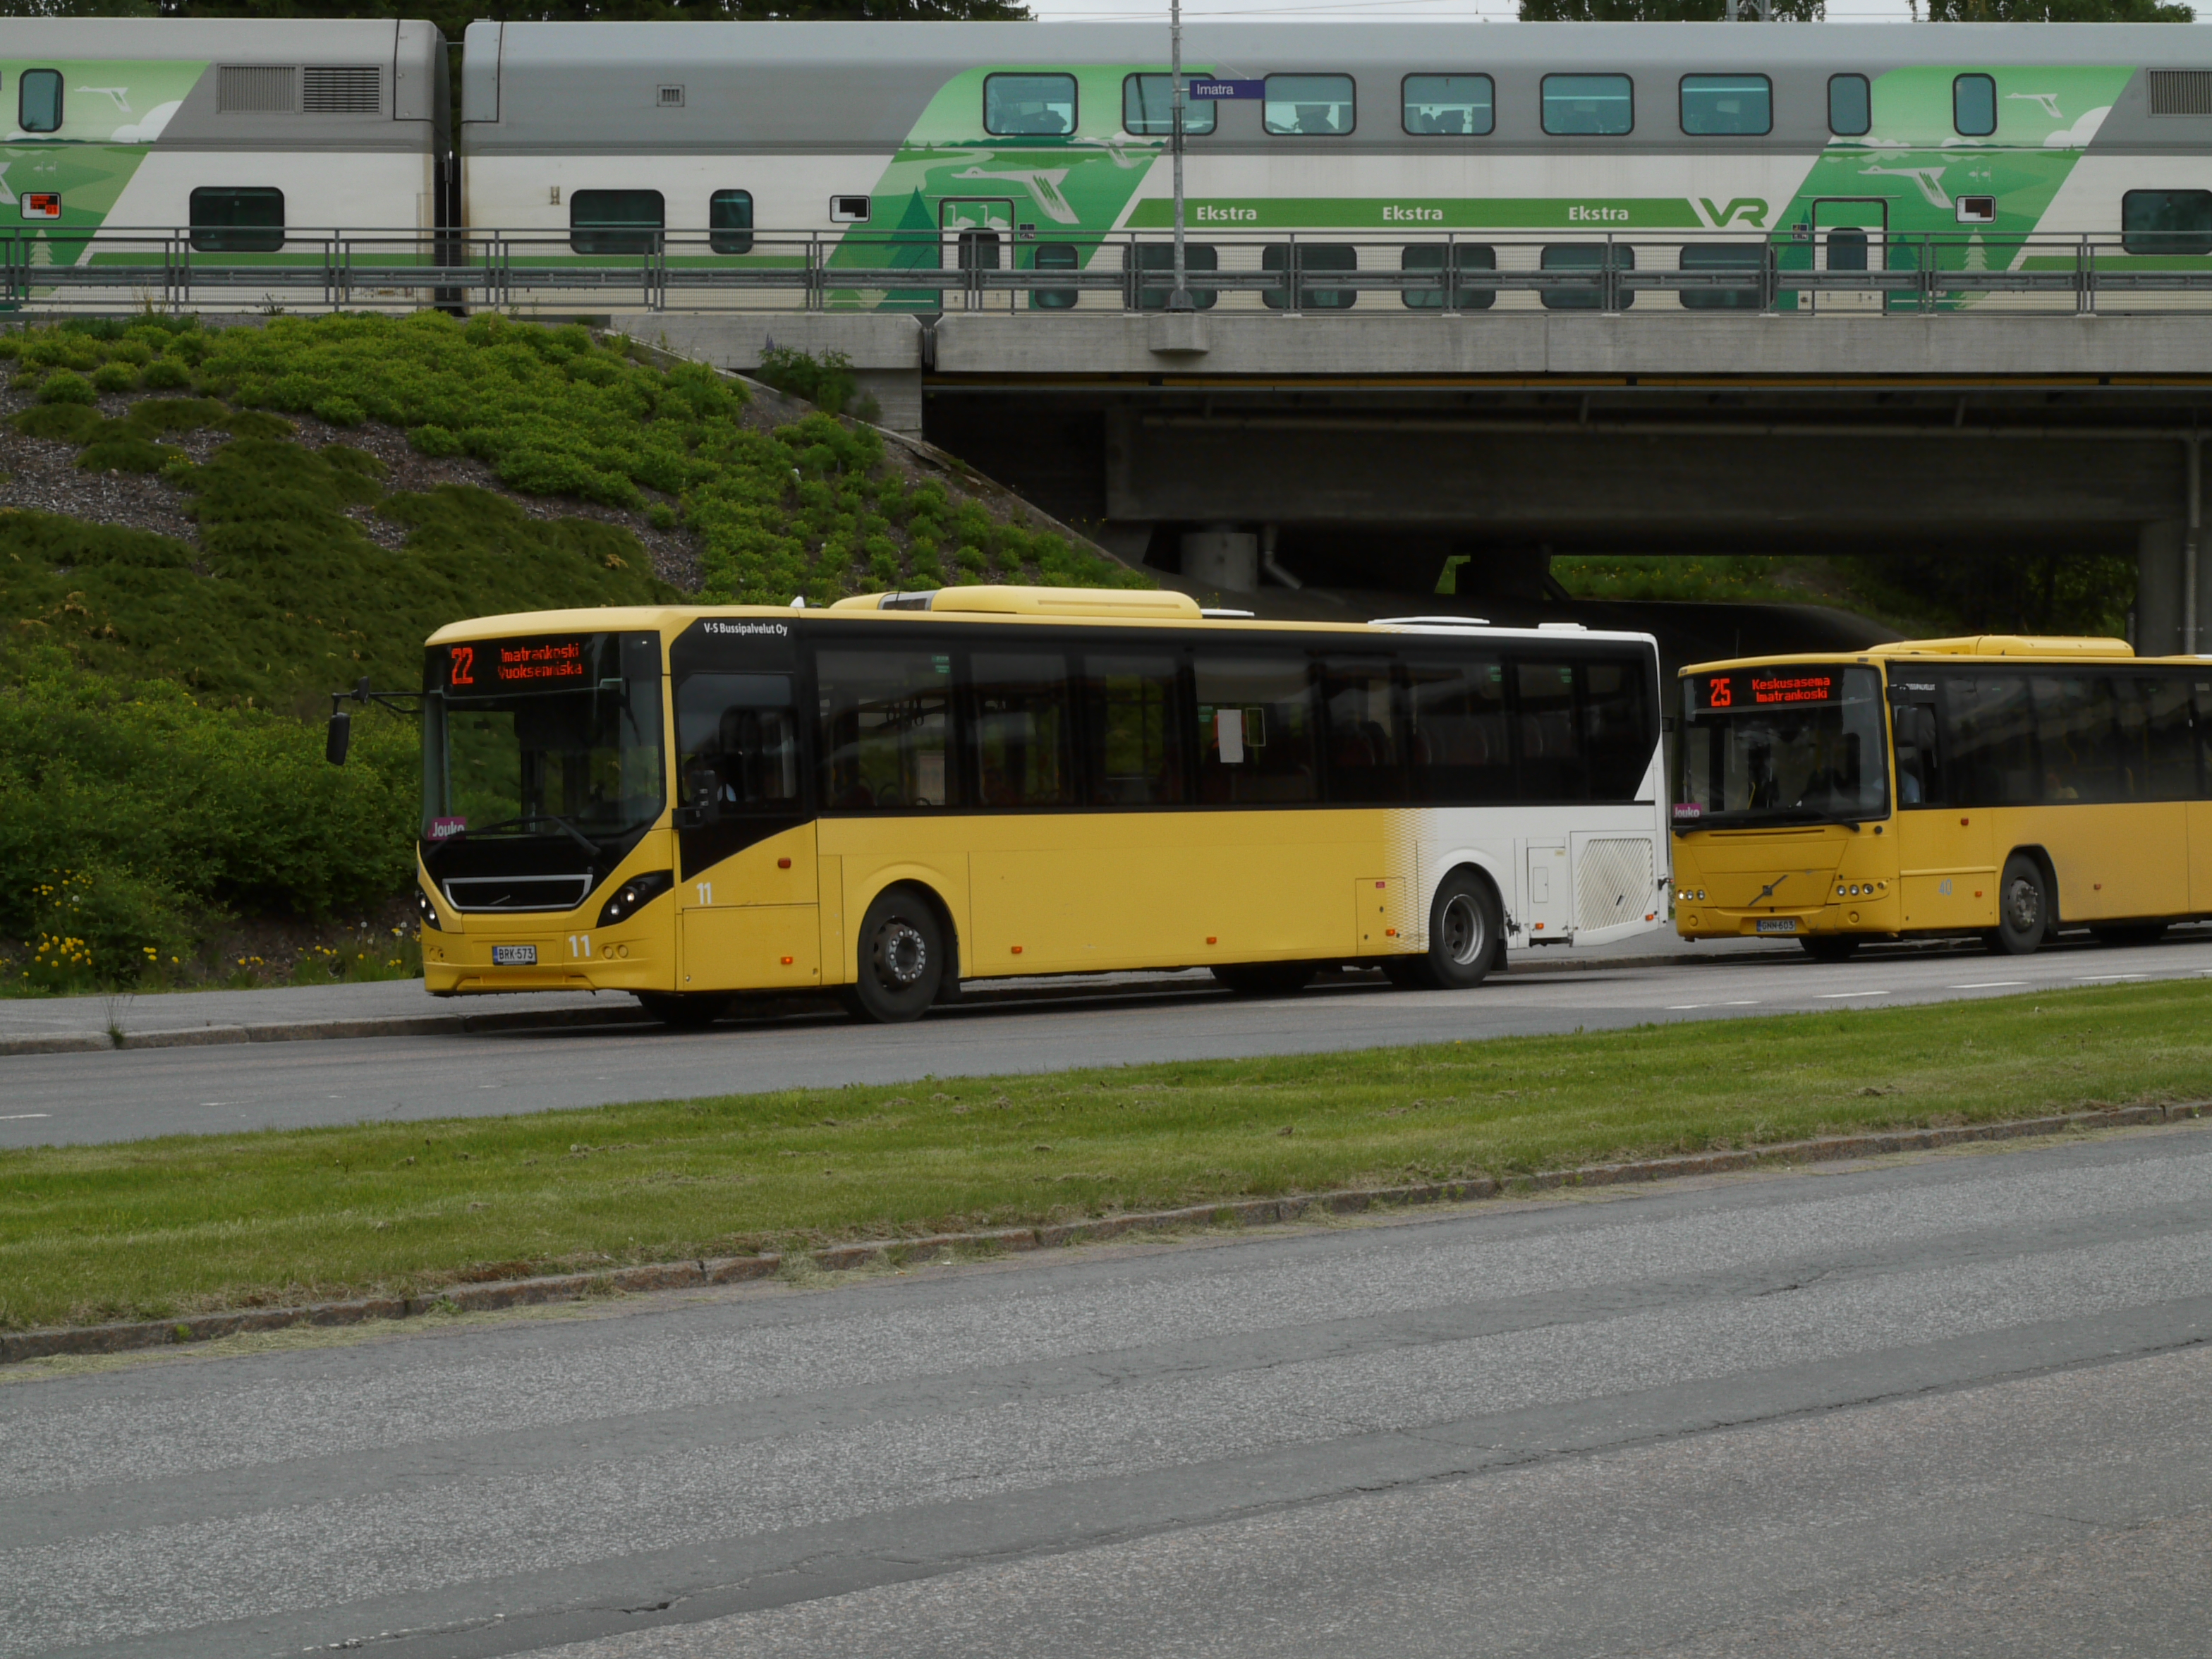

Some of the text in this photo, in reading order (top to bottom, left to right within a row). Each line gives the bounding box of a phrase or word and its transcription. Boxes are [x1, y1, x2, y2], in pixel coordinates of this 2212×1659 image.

[1196, 83, 1234, 95] Imatra
[1196, 205, 1258, 221] Ekstra
[1382, 205, 1443, 221] Ekstra
[1569, 205, 1629, 221] Ekstra
[1699, 198, 1769, 228] VR
[703, 622, 788, 637] V-S Bussipalvelut Oy
[500, 643, 580, 663] Imatrankoski
[451, 647, 474, 685] 22
[497, 661, 583, 680] Vuoksenniska
[1751, 676, 1831, 691] Keskusasema
[1710, 678, 1732, 707] 25
[1756, 688, 1828, 703] Imatrankoski
[1674, 806, 1701, 818] Jouko
[432, 820, 466, 837] Jouko
[696, 882, 712, 906] 11
[1938, 878, 1953, 897] 40
[498, 947, 534, 960] BRK-573
[568, 934, 591, 958] 11
